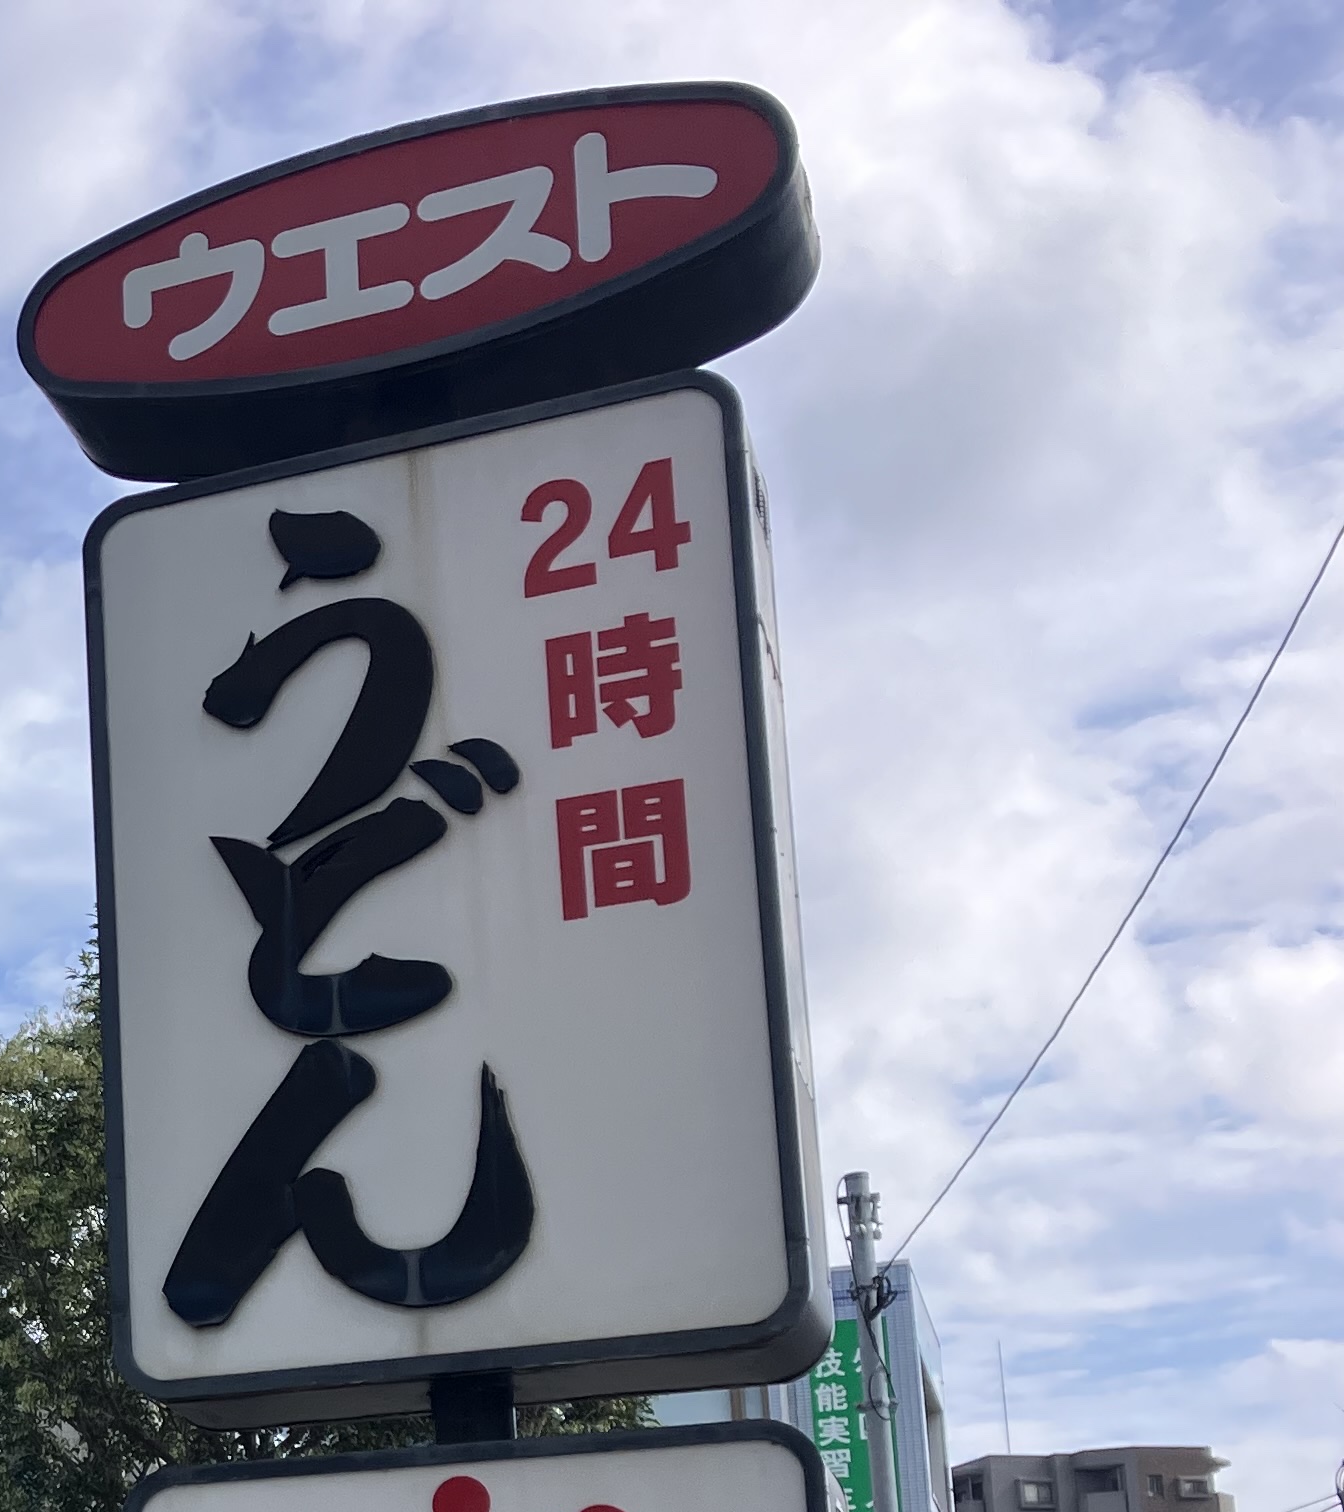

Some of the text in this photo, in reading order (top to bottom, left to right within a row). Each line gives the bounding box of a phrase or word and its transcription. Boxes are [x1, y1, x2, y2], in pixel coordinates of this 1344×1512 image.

[123, 132, 718, 361] ウエスト
[162, 508, 535, 1328] うどん
[520, 457, 692, 922] 24時間
